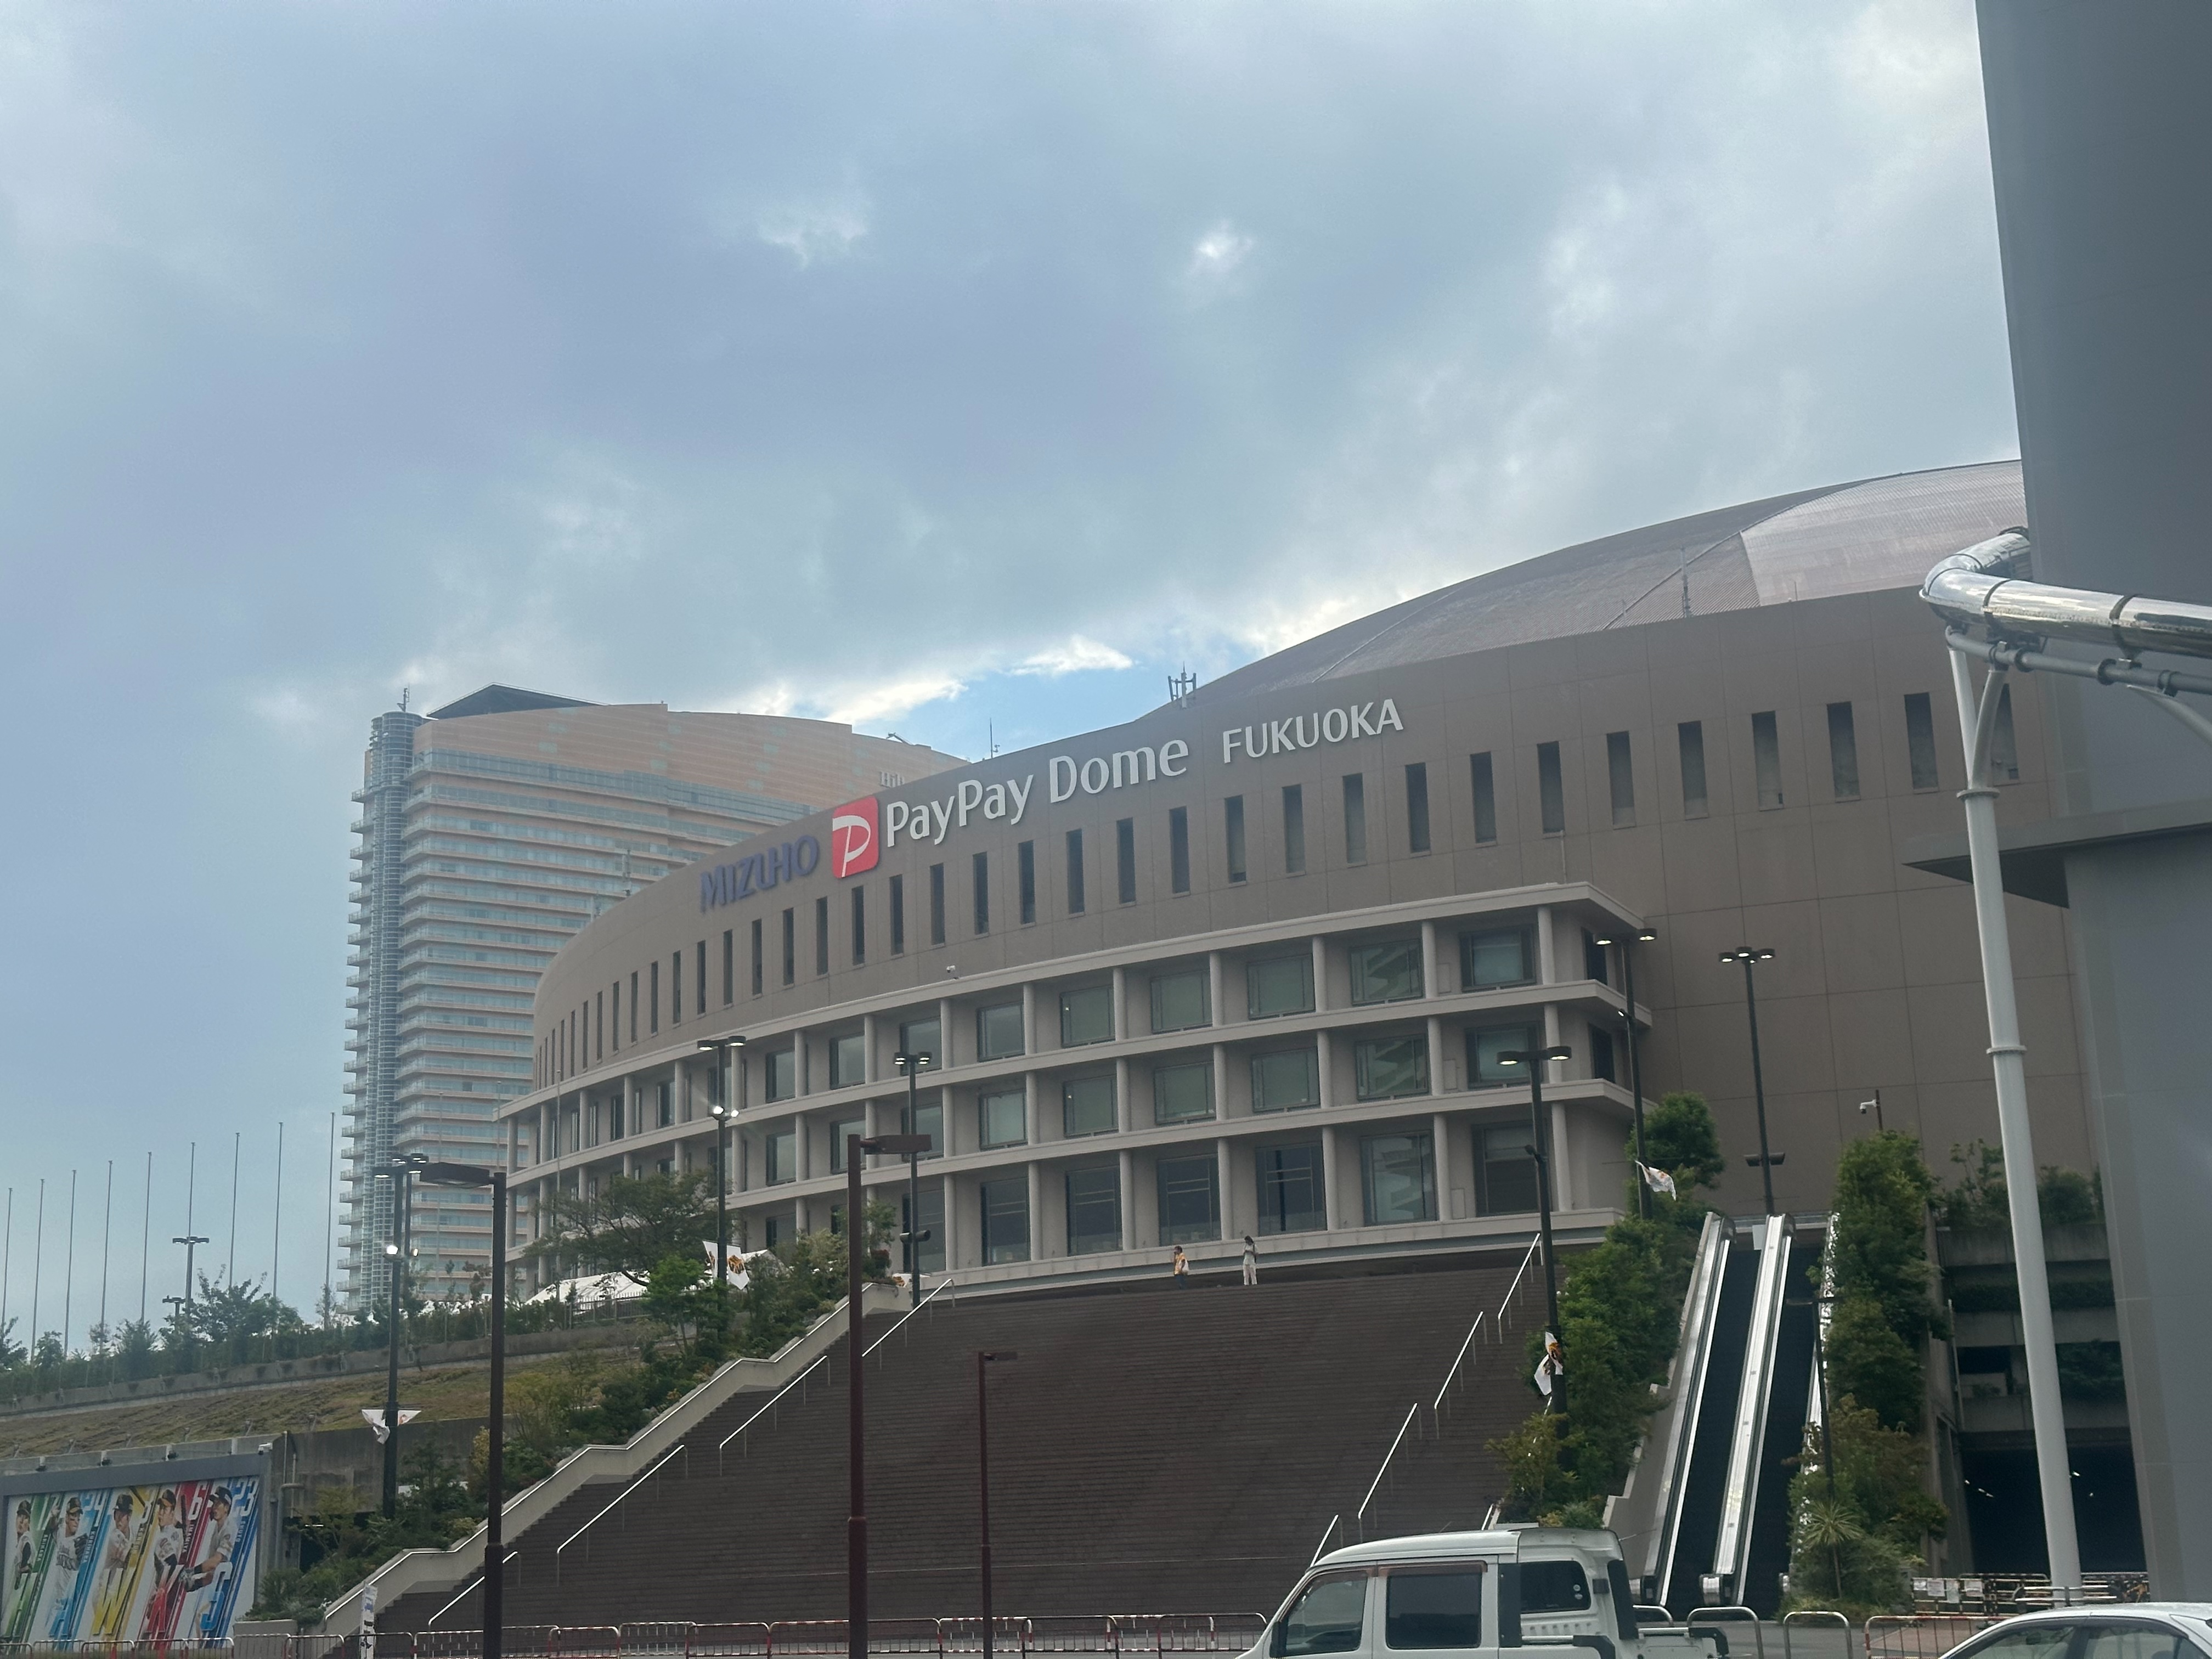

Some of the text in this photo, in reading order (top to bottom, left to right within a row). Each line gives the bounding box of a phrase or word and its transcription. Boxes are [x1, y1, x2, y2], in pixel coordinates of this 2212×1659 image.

[700, 835, 819, 914] MIZUHO
[887, 774, 1034, 848] PayPay
[1049, 740, 1189, 803] Dome
[1223, 698, 1404, 764] FUKUOKA
[188, 1482, 208, 1521] 6
[229, 1477, 259, 1517] 23
